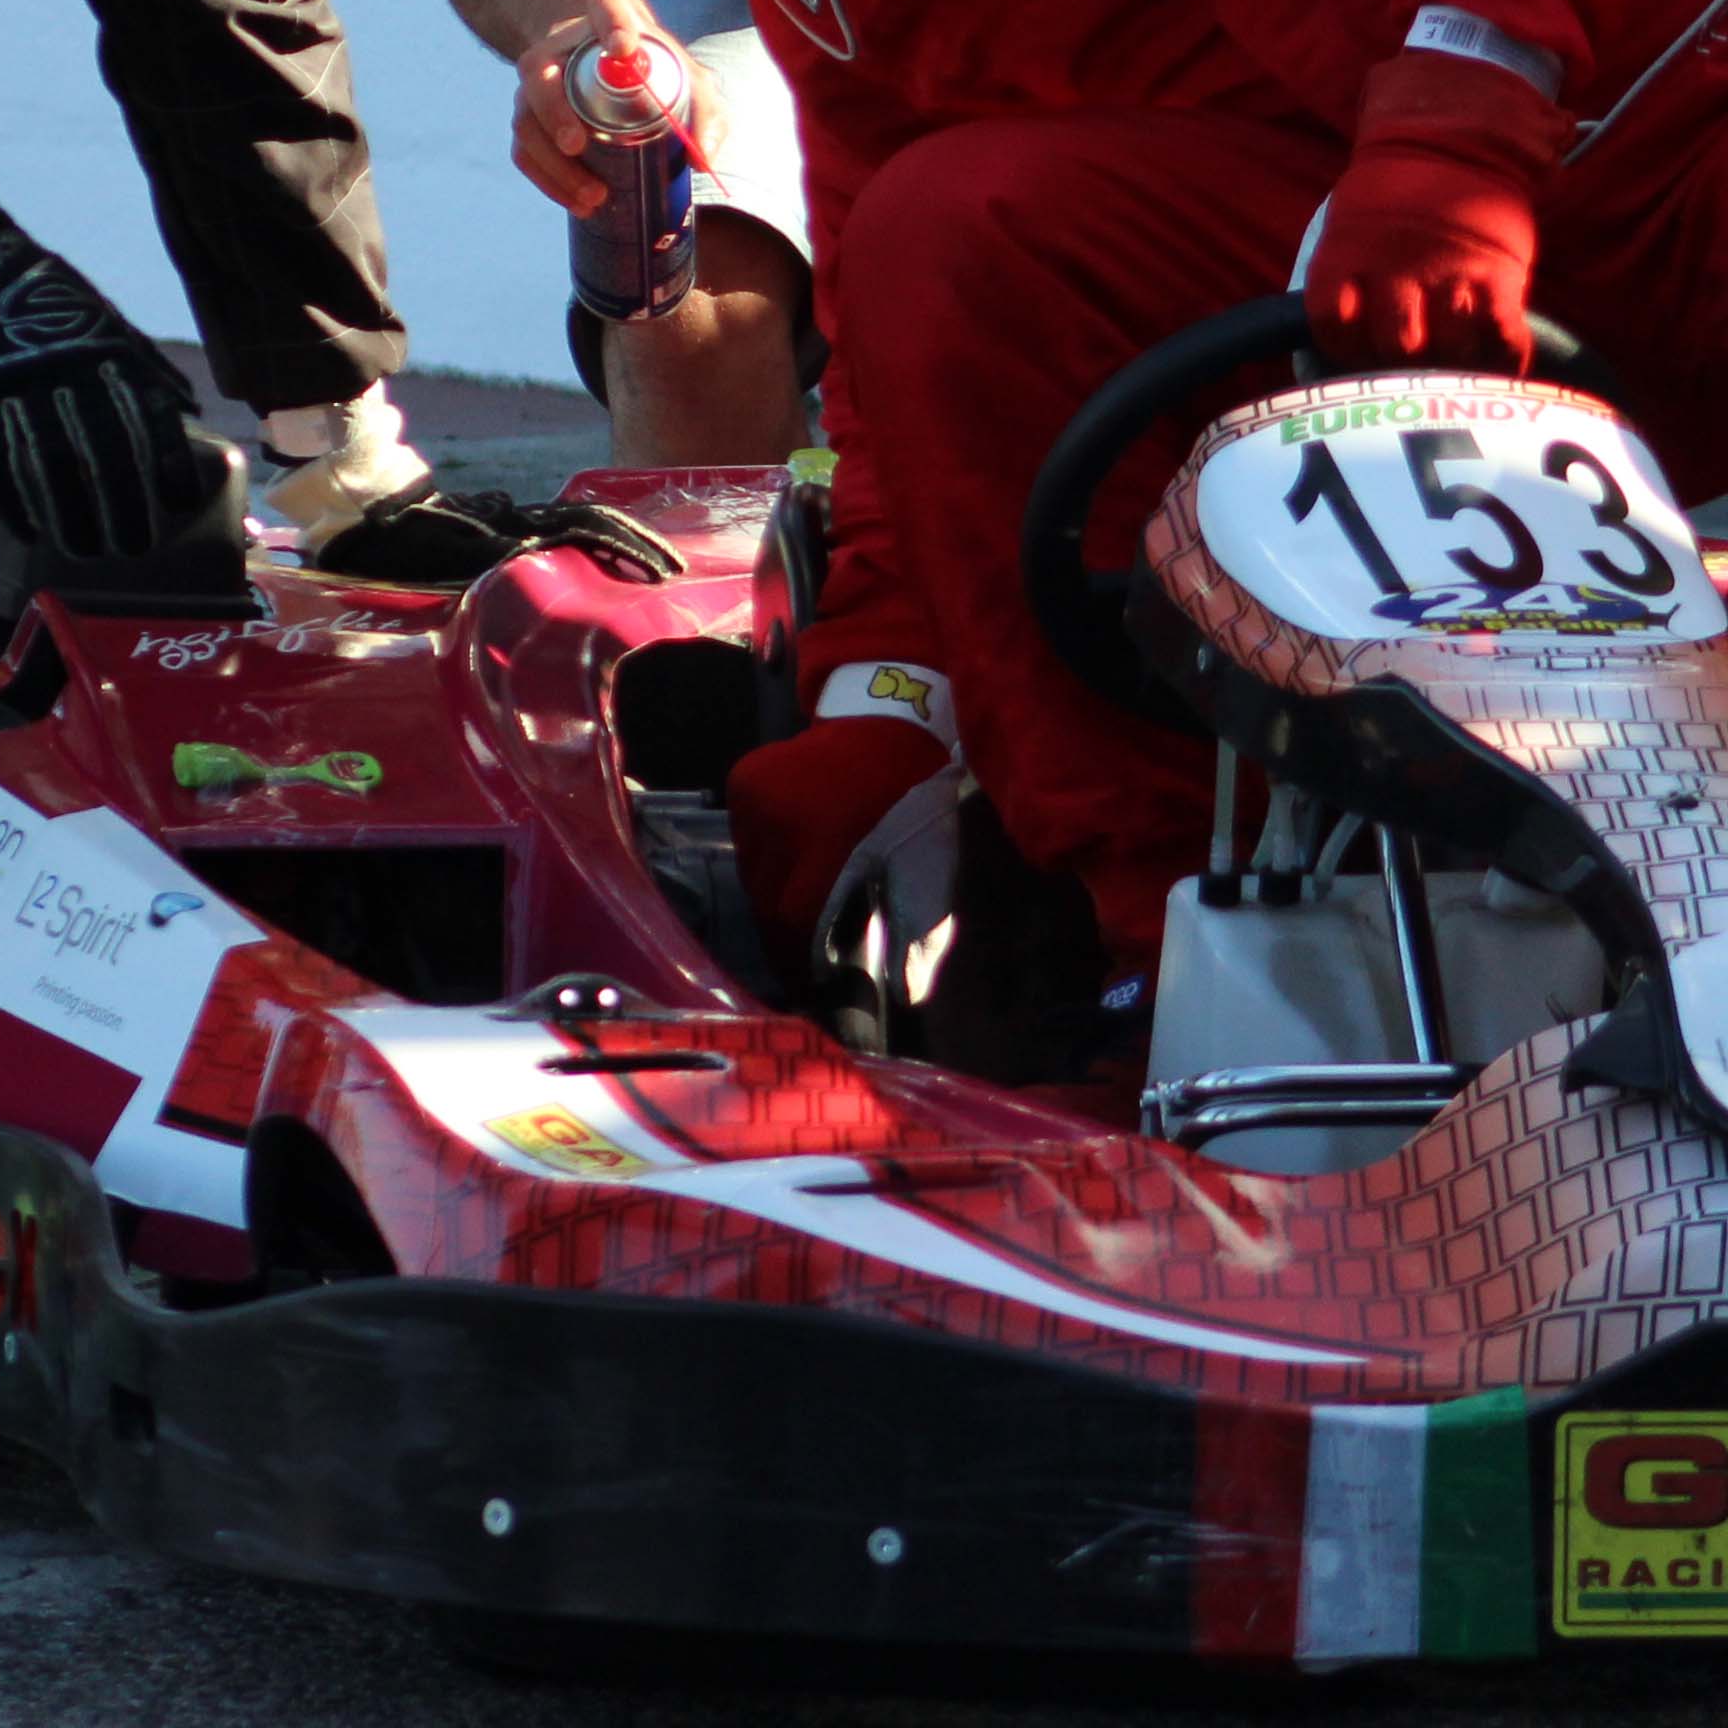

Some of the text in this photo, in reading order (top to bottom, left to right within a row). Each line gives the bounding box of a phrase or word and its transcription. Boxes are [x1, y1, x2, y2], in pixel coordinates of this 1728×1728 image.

[1279, 398, 1546, 446] EUROINDY
[1283, 428, 1675, 596] 153
[1410, 583, 1589, 618] 24
[44, 884, 138, 967] Spirit
